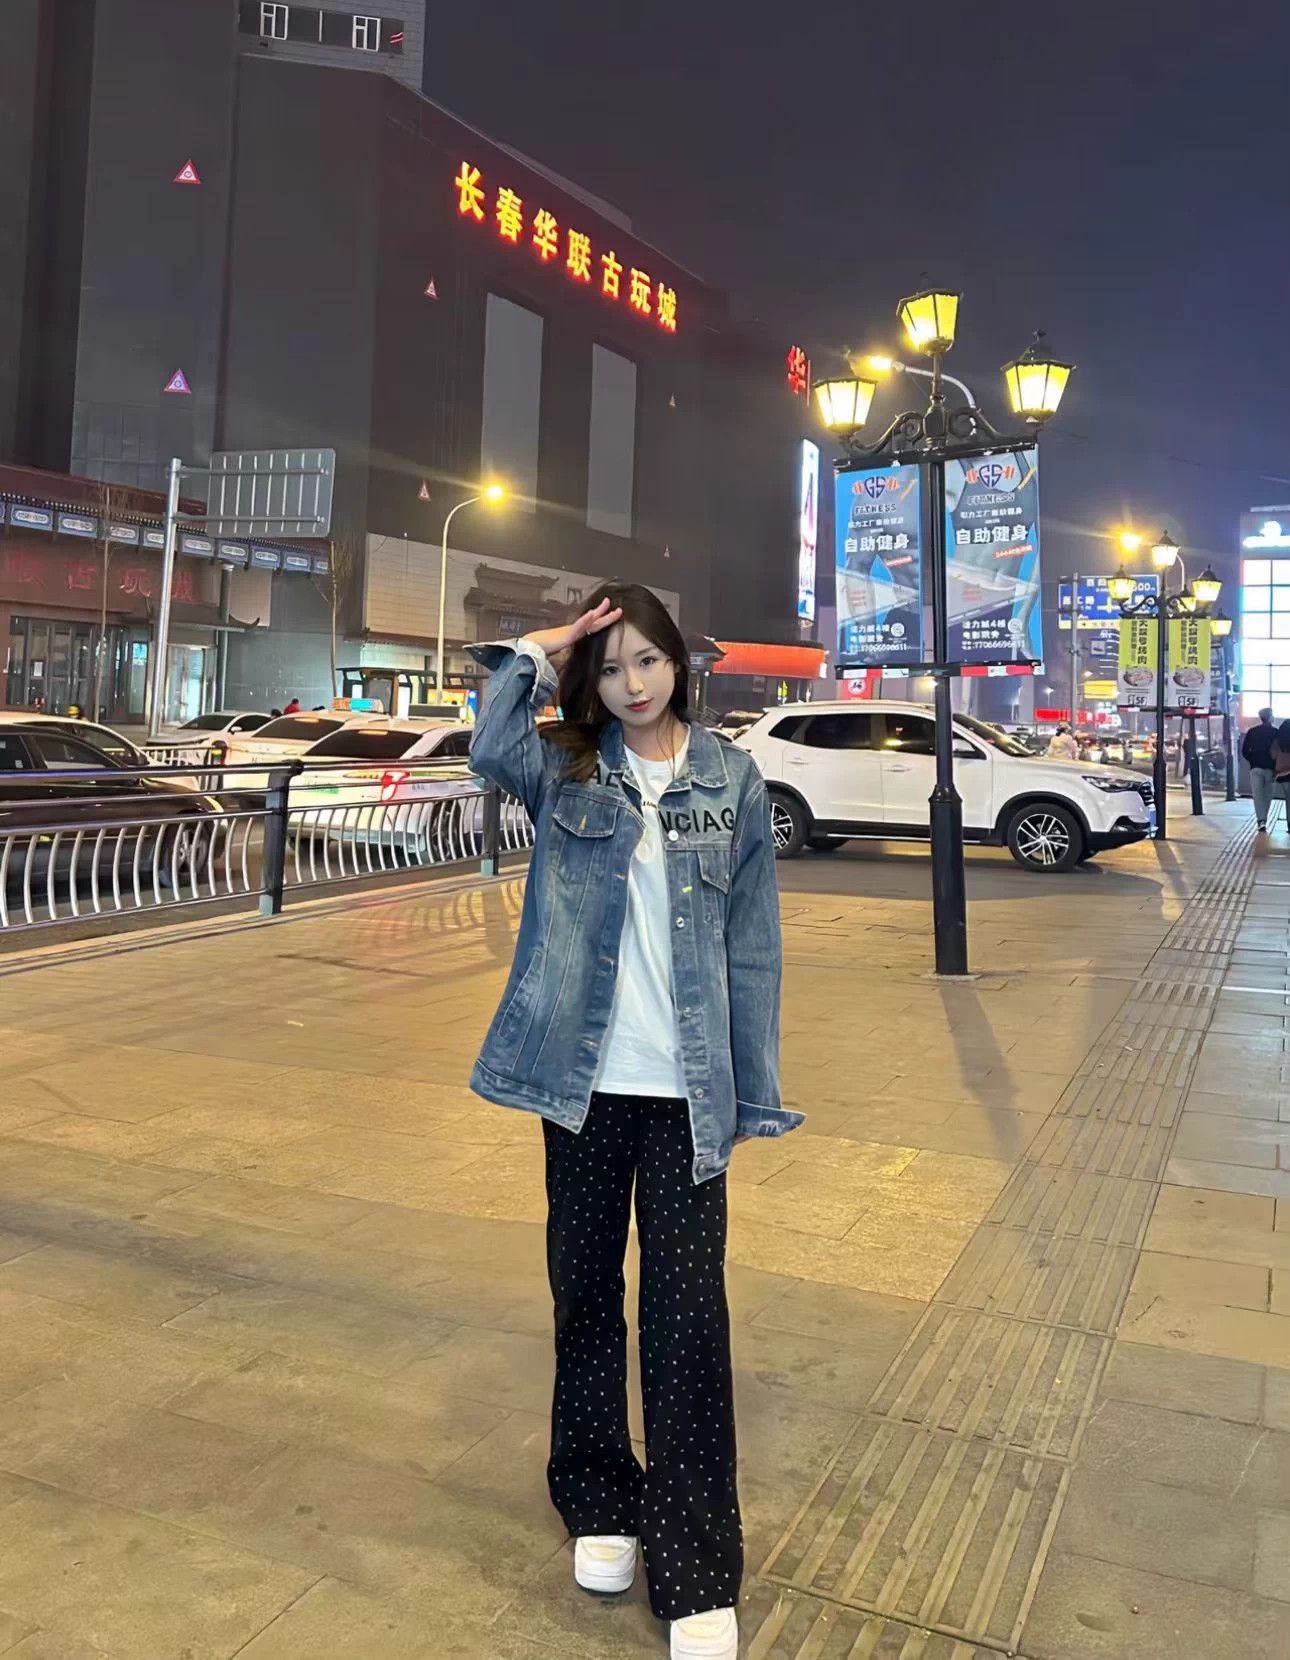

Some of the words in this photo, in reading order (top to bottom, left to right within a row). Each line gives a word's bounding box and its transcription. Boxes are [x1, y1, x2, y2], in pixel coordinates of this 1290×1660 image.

[455, 161, 678, 331] 长春华联古玩城
[845, 533, 910, 553] 自助健身
[956, 524, 1028, 545] 自助健身
